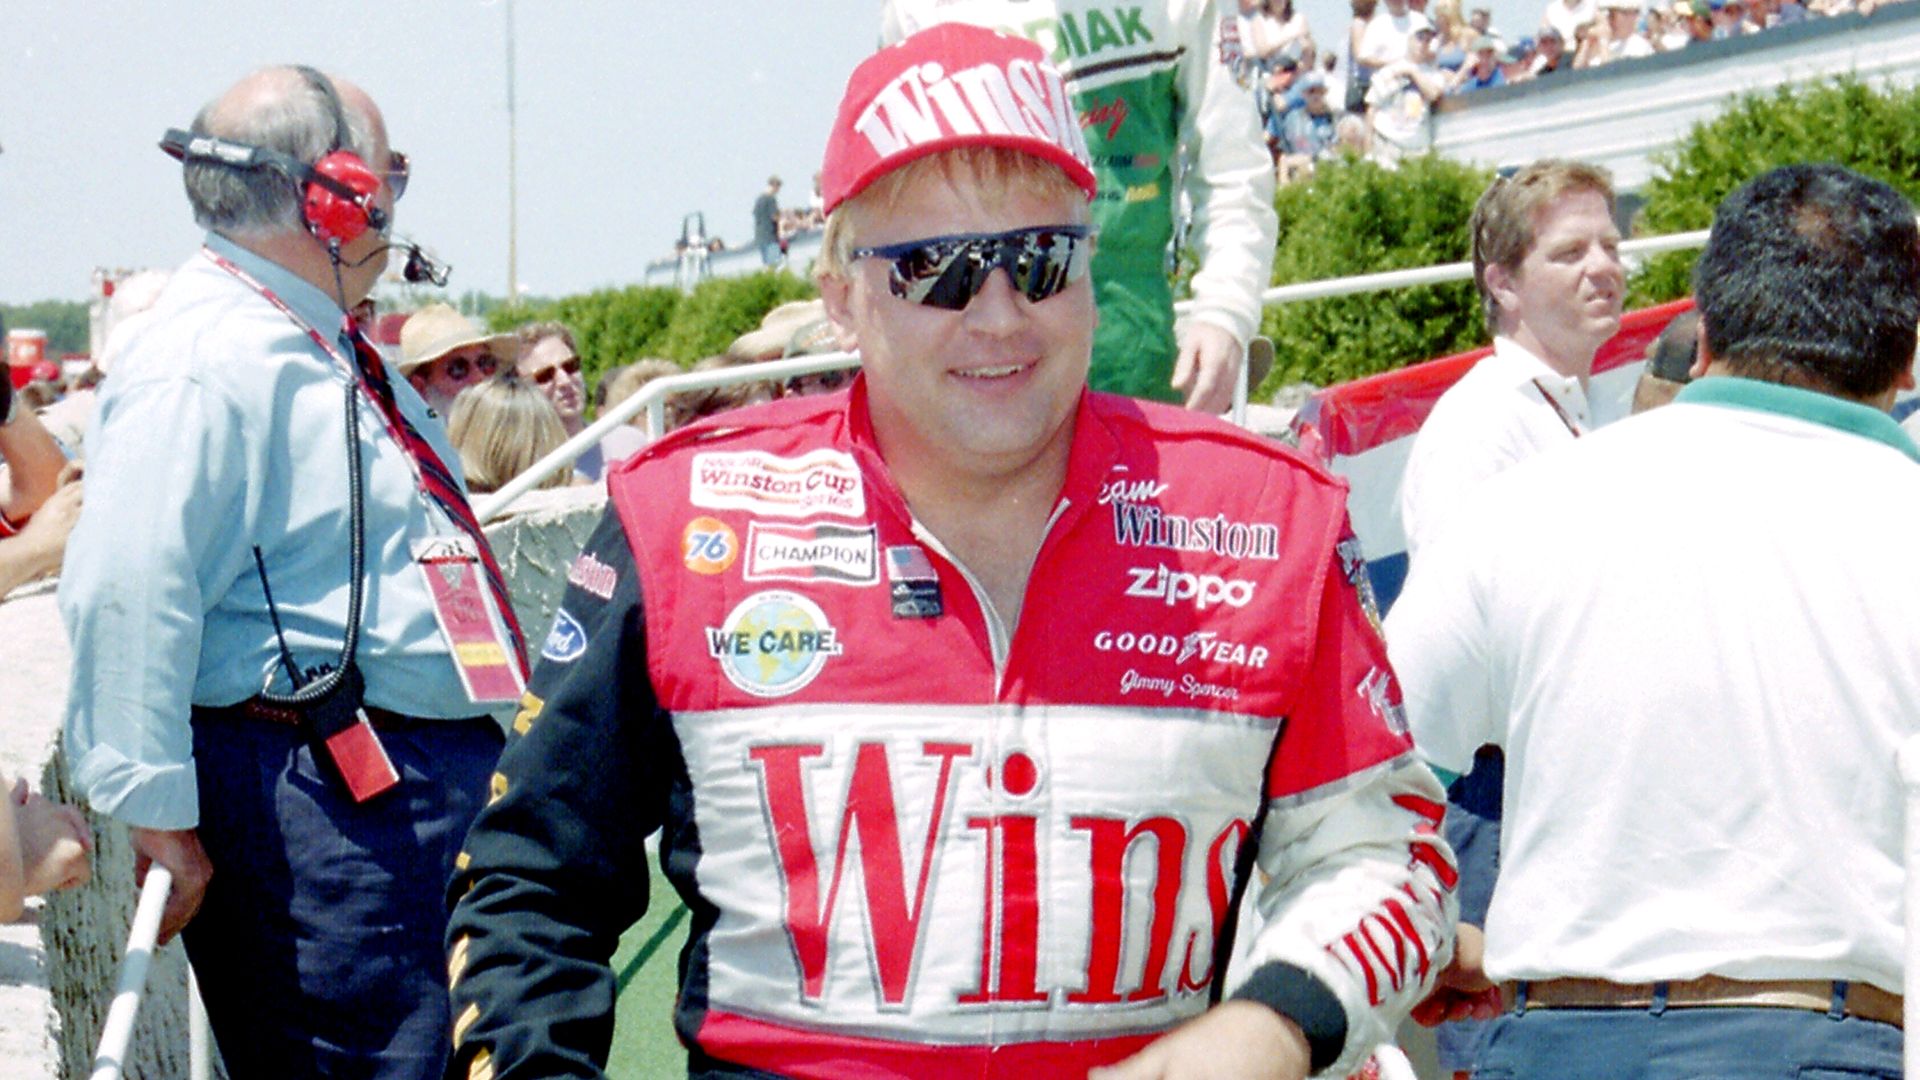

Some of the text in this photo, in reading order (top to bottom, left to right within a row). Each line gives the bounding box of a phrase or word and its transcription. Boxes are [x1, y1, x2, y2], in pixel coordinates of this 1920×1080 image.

[1000, 6, 1154, 63] DIAK
[701, 469, 857, 494] Winston Cup
[1098, 465, 1168, 504] eam
[1112, 500, 1280, 560] Winston
[687, 530, 728, 562] 76
[758, 544, 868, 564] CHAMPION
[712, 630, 751, 656] WE
[1120, 669, 1240, 700] Jimmy Spencer
